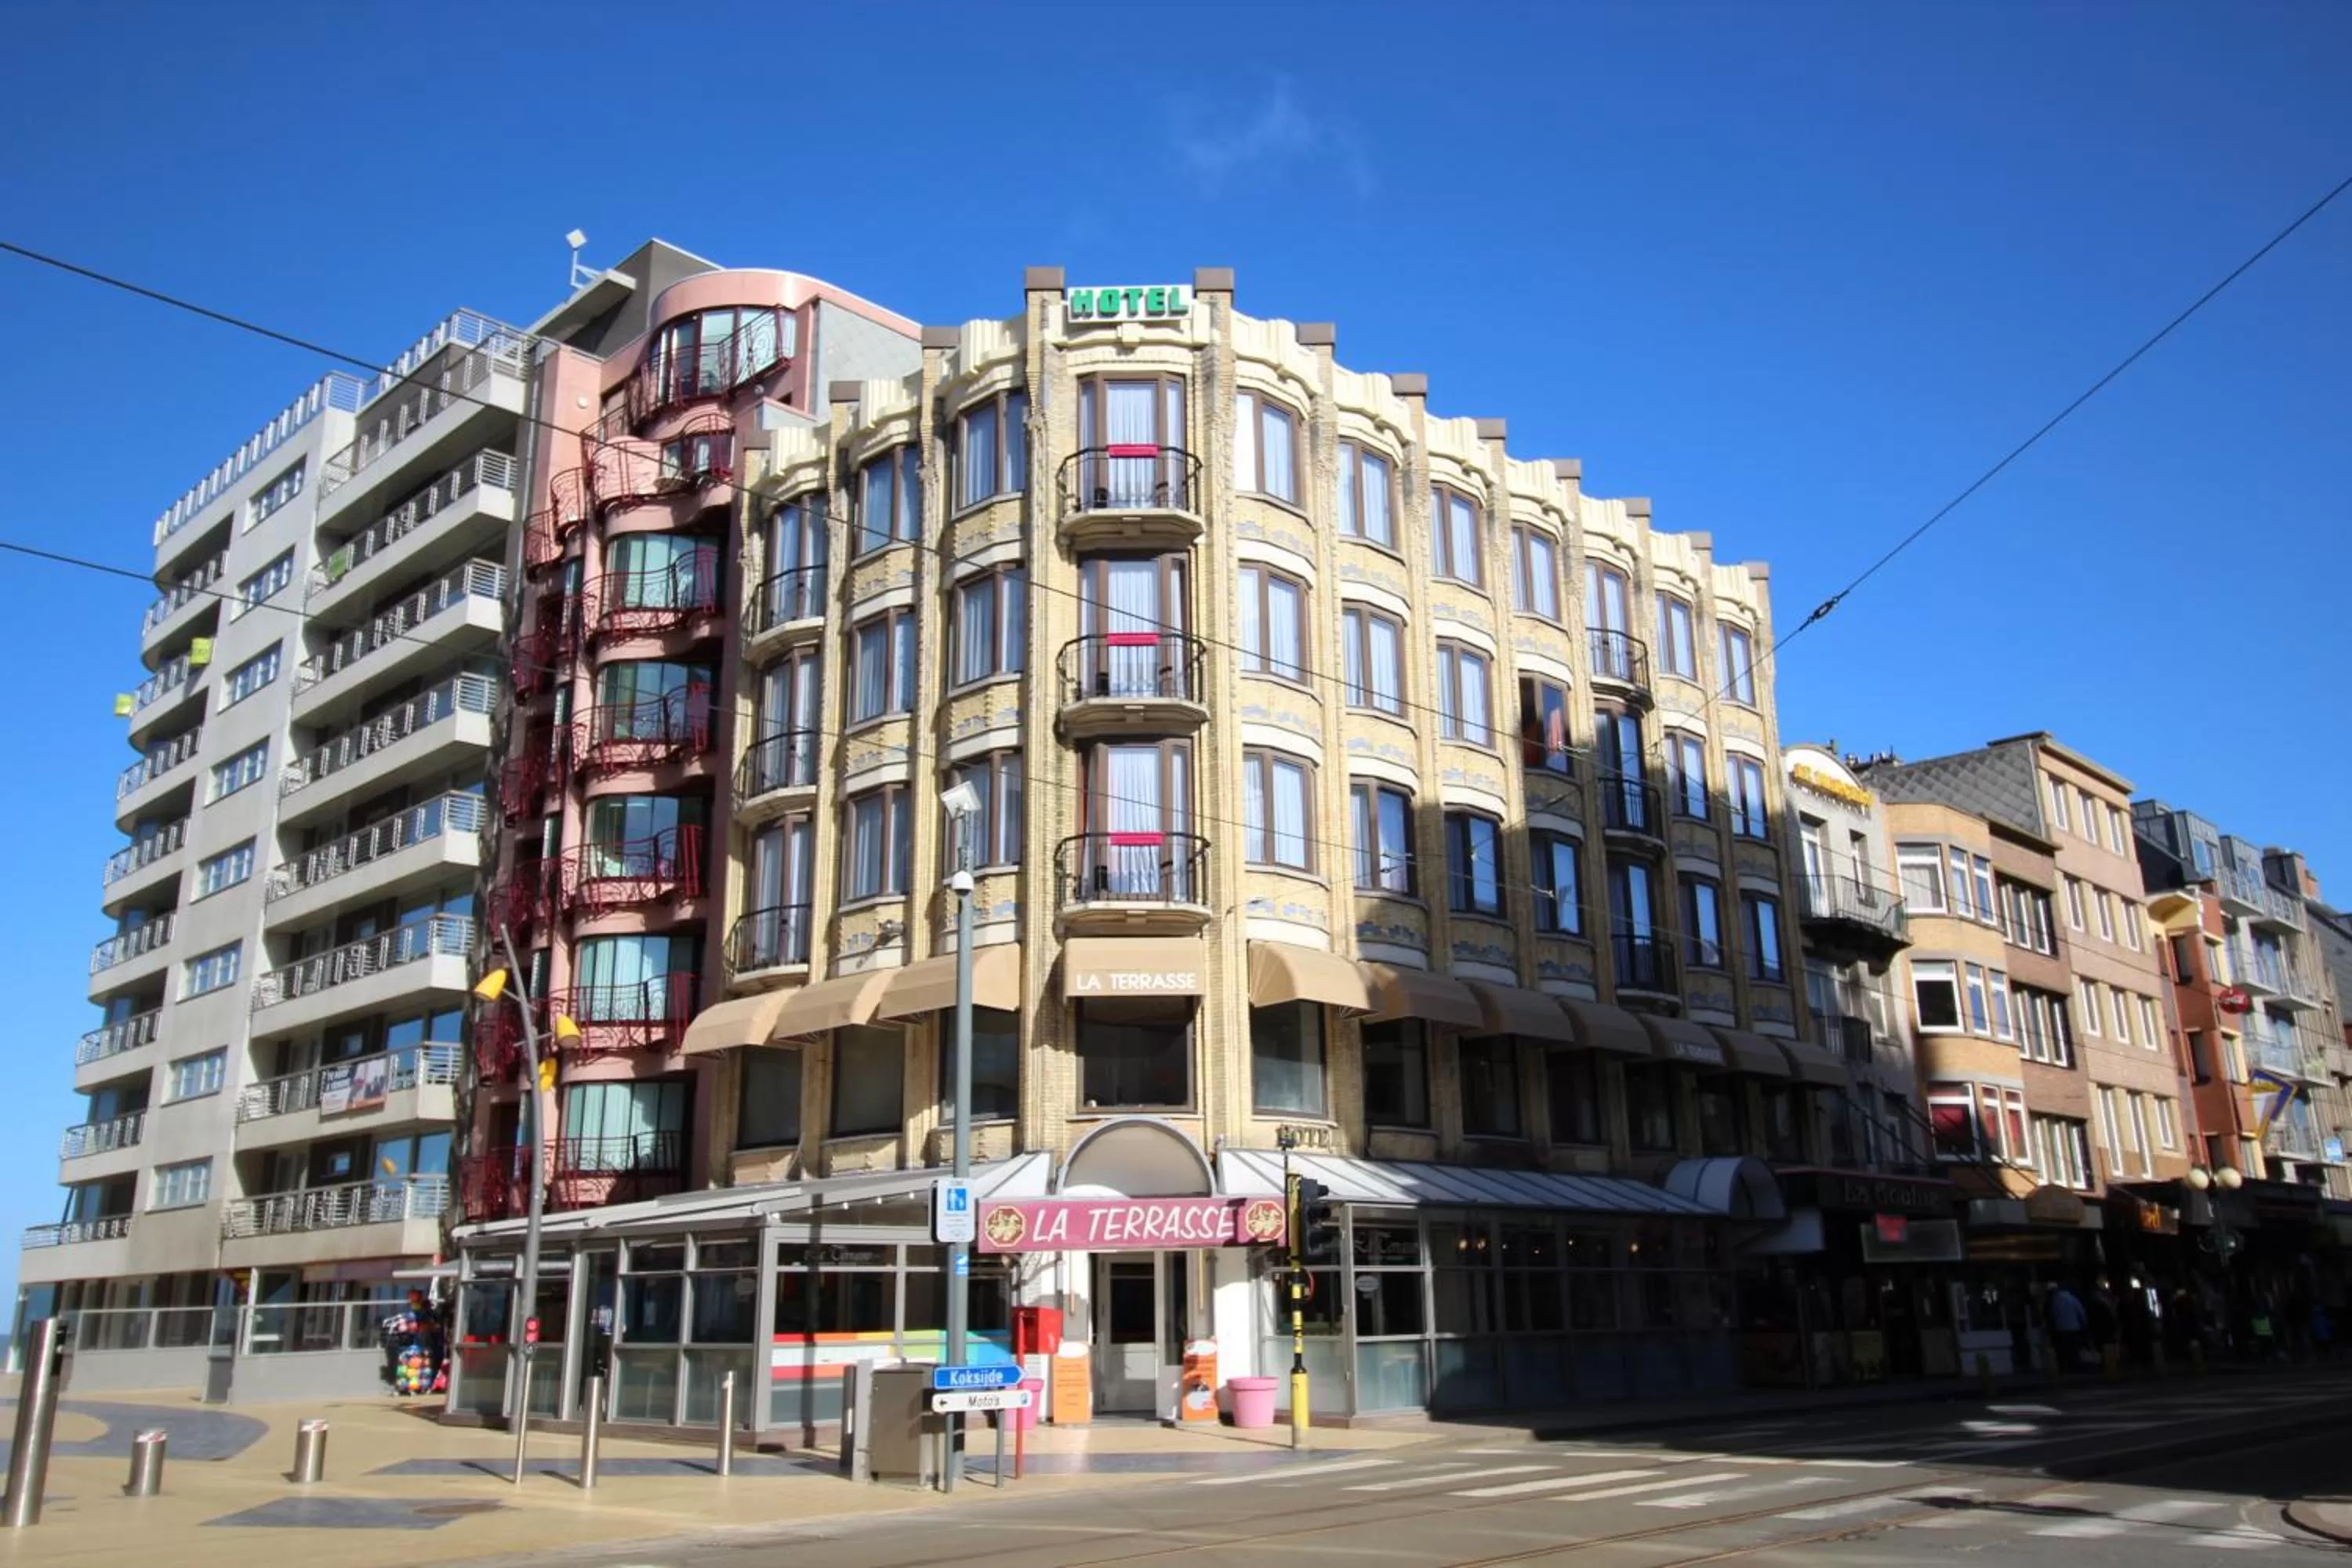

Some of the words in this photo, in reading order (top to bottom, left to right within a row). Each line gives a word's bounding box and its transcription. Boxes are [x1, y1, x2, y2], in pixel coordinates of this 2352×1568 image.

[1072, 287, 1189, 318] HOTEL
[1076, 973, 1102, 991] LA
[1109, 972, 1197, 991] TERRASSE
[1032, 1208, 1069, 1243] LA
[1087, 1205, 1236, 1243] TERRASSE
[949, 1369, 1004, 1386] Koksijde
